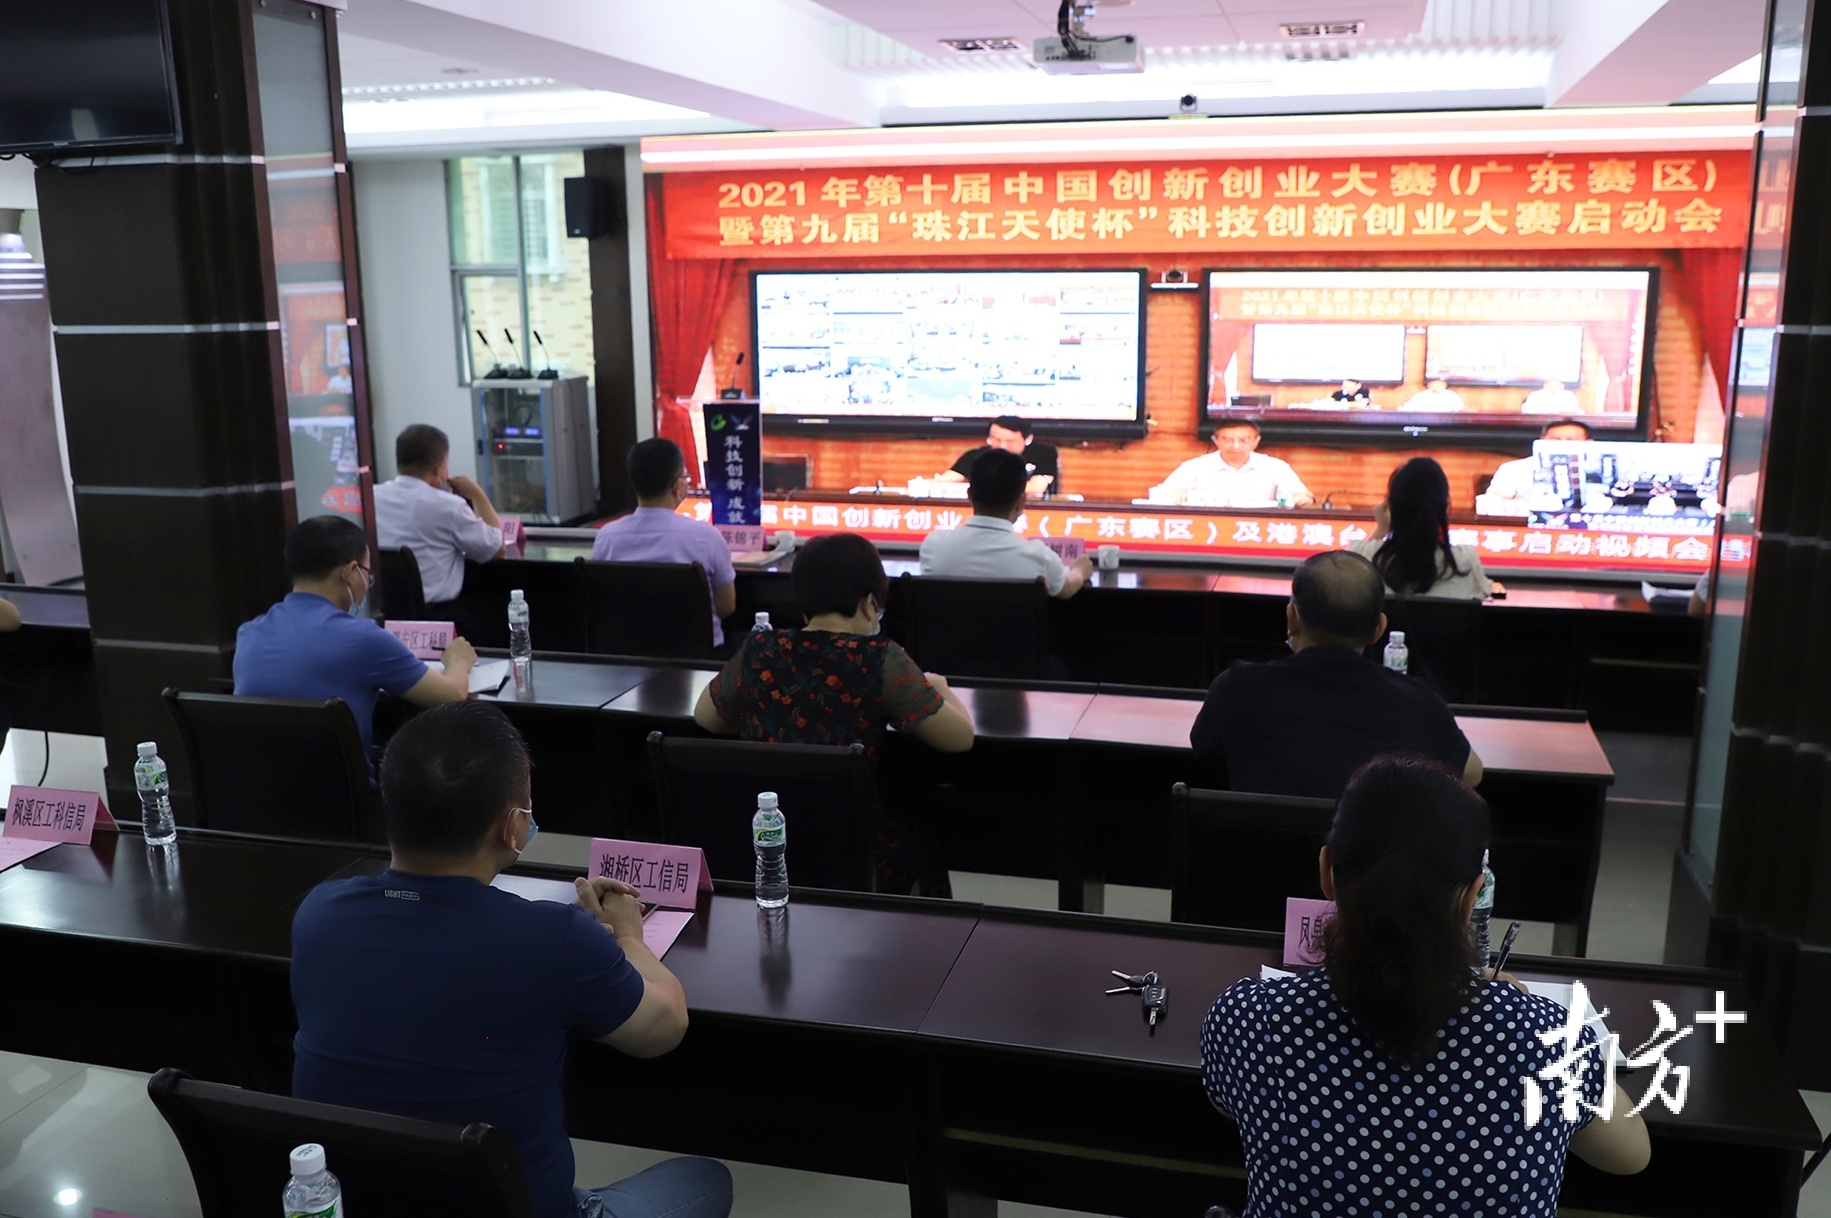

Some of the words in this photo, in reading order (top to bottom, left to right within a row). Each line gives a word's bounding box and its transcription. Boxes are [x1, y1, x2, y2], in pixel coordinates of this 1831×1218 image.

[12, 797, 86, 831] 枫溪区工科信局
[599, 854, 689, 894] 湘桥区工信局
